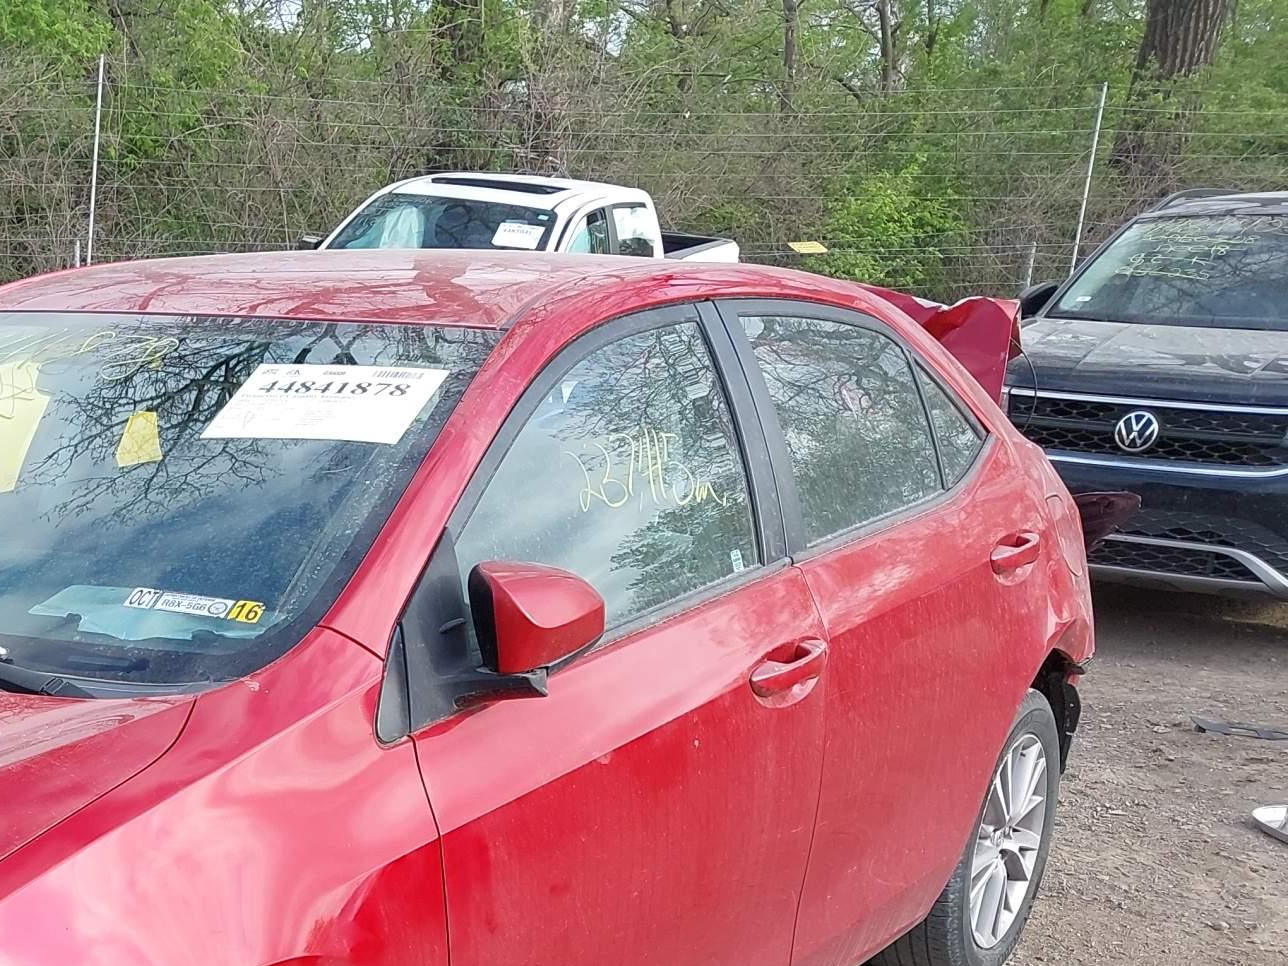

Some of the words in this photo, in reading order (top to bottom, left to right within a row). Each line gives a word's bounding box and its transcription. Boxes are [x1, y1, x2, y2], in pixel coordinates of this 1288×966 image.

[259, 380, 411, 397] 44841878
[128, 589, 160, 608] OCT
[232, 602, 260, 622] 16
